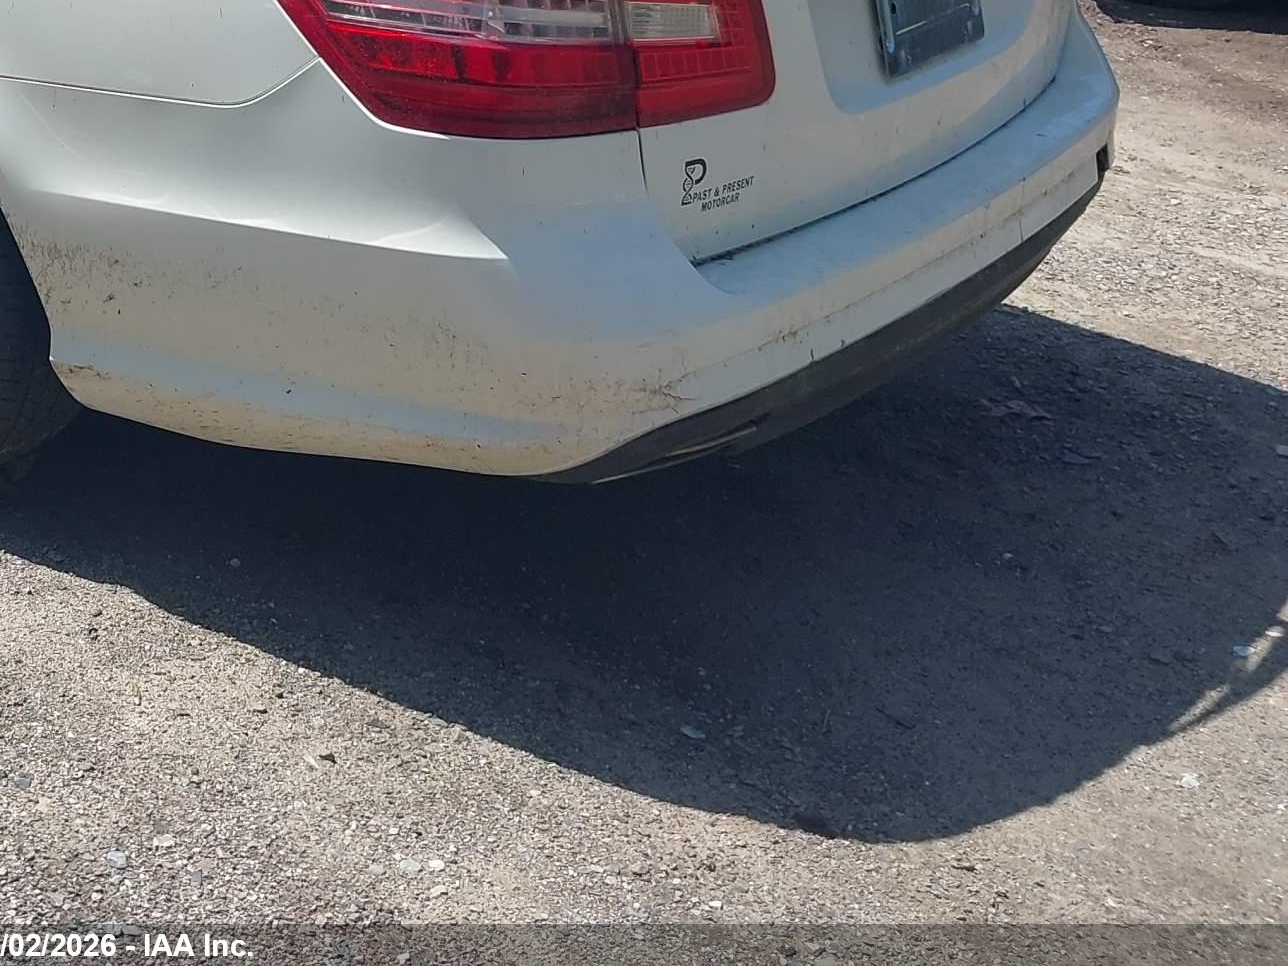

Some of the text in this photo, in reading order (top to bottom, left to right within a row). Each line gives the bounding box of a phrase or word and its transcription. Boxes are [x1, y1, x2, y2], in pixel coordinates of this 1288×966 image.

[692, 175, 754, 203] PAST & PRESENT
[701, 192, 741, 212] MOTORCAR
